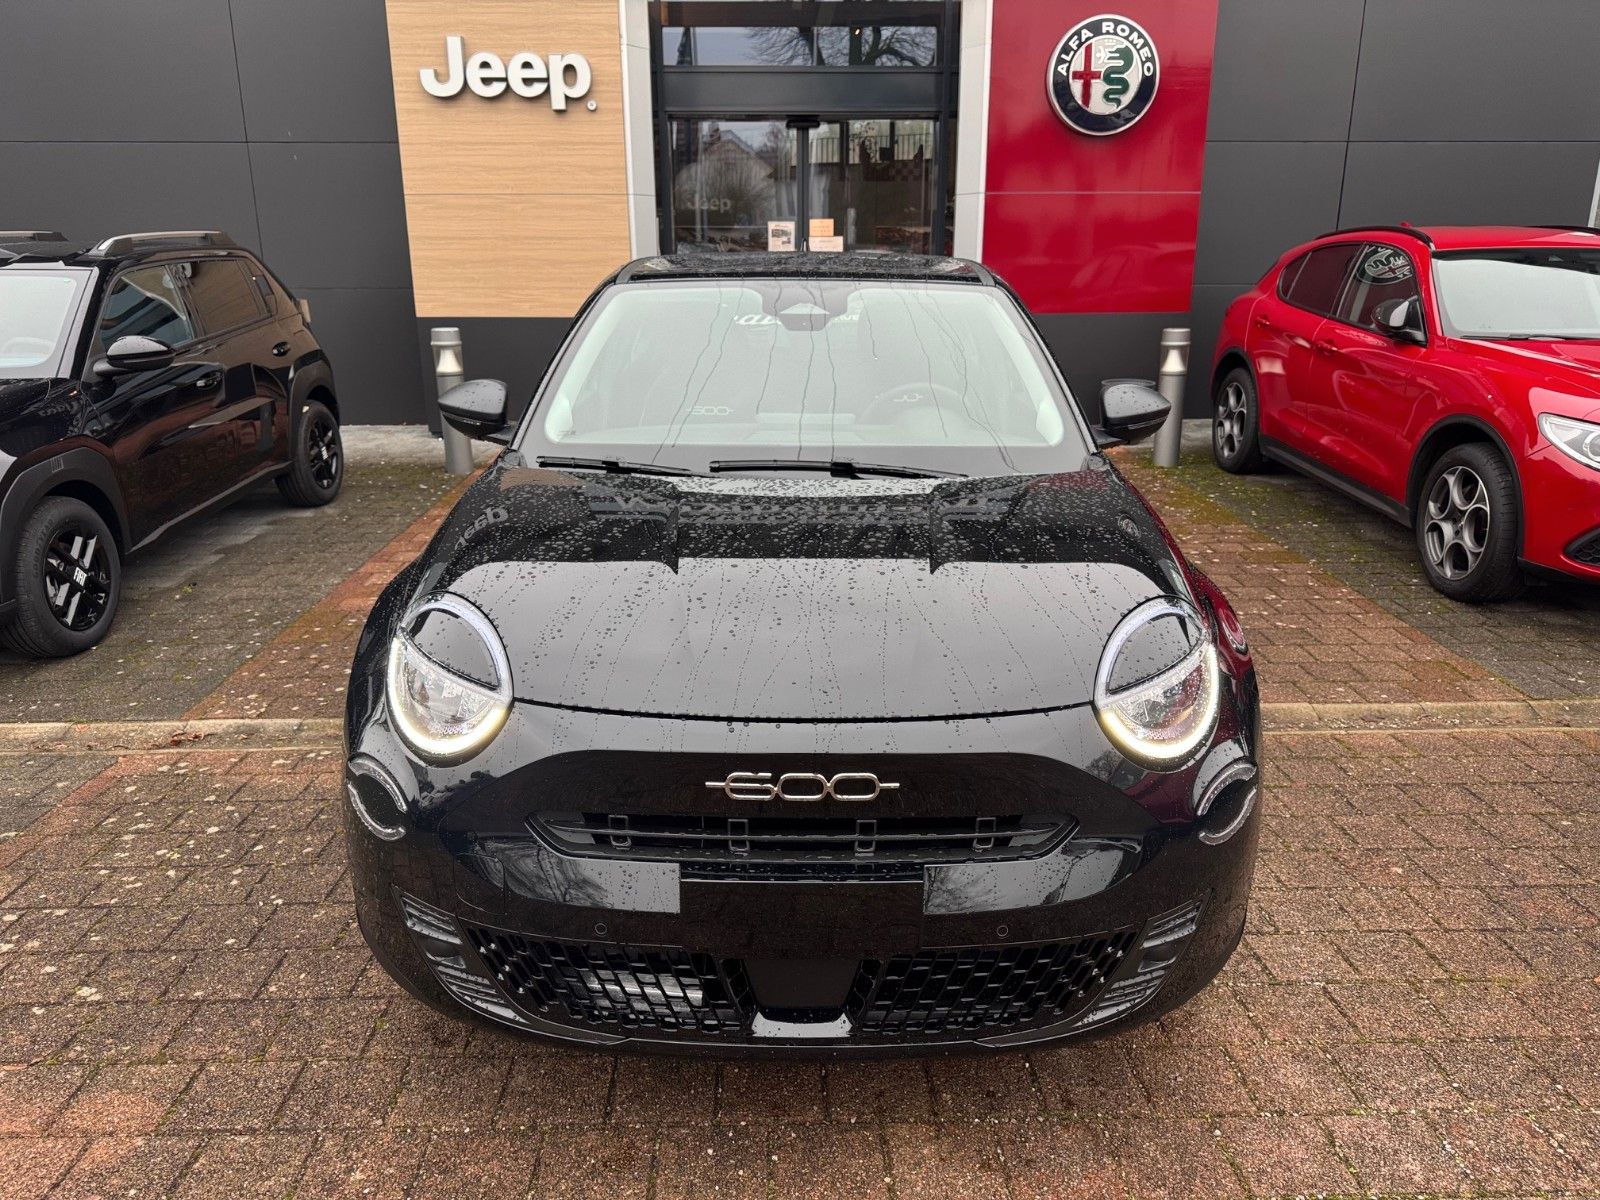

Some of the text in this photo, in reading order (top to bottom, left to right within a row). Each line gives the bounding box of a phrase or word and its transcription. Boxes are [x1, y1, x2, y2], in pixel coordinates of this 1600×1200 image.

[419, 35, 592, 111] Jeep
[1057, 21, 1154, 77] ALFA ROMEO
[705, 771, 901, 802] 600
